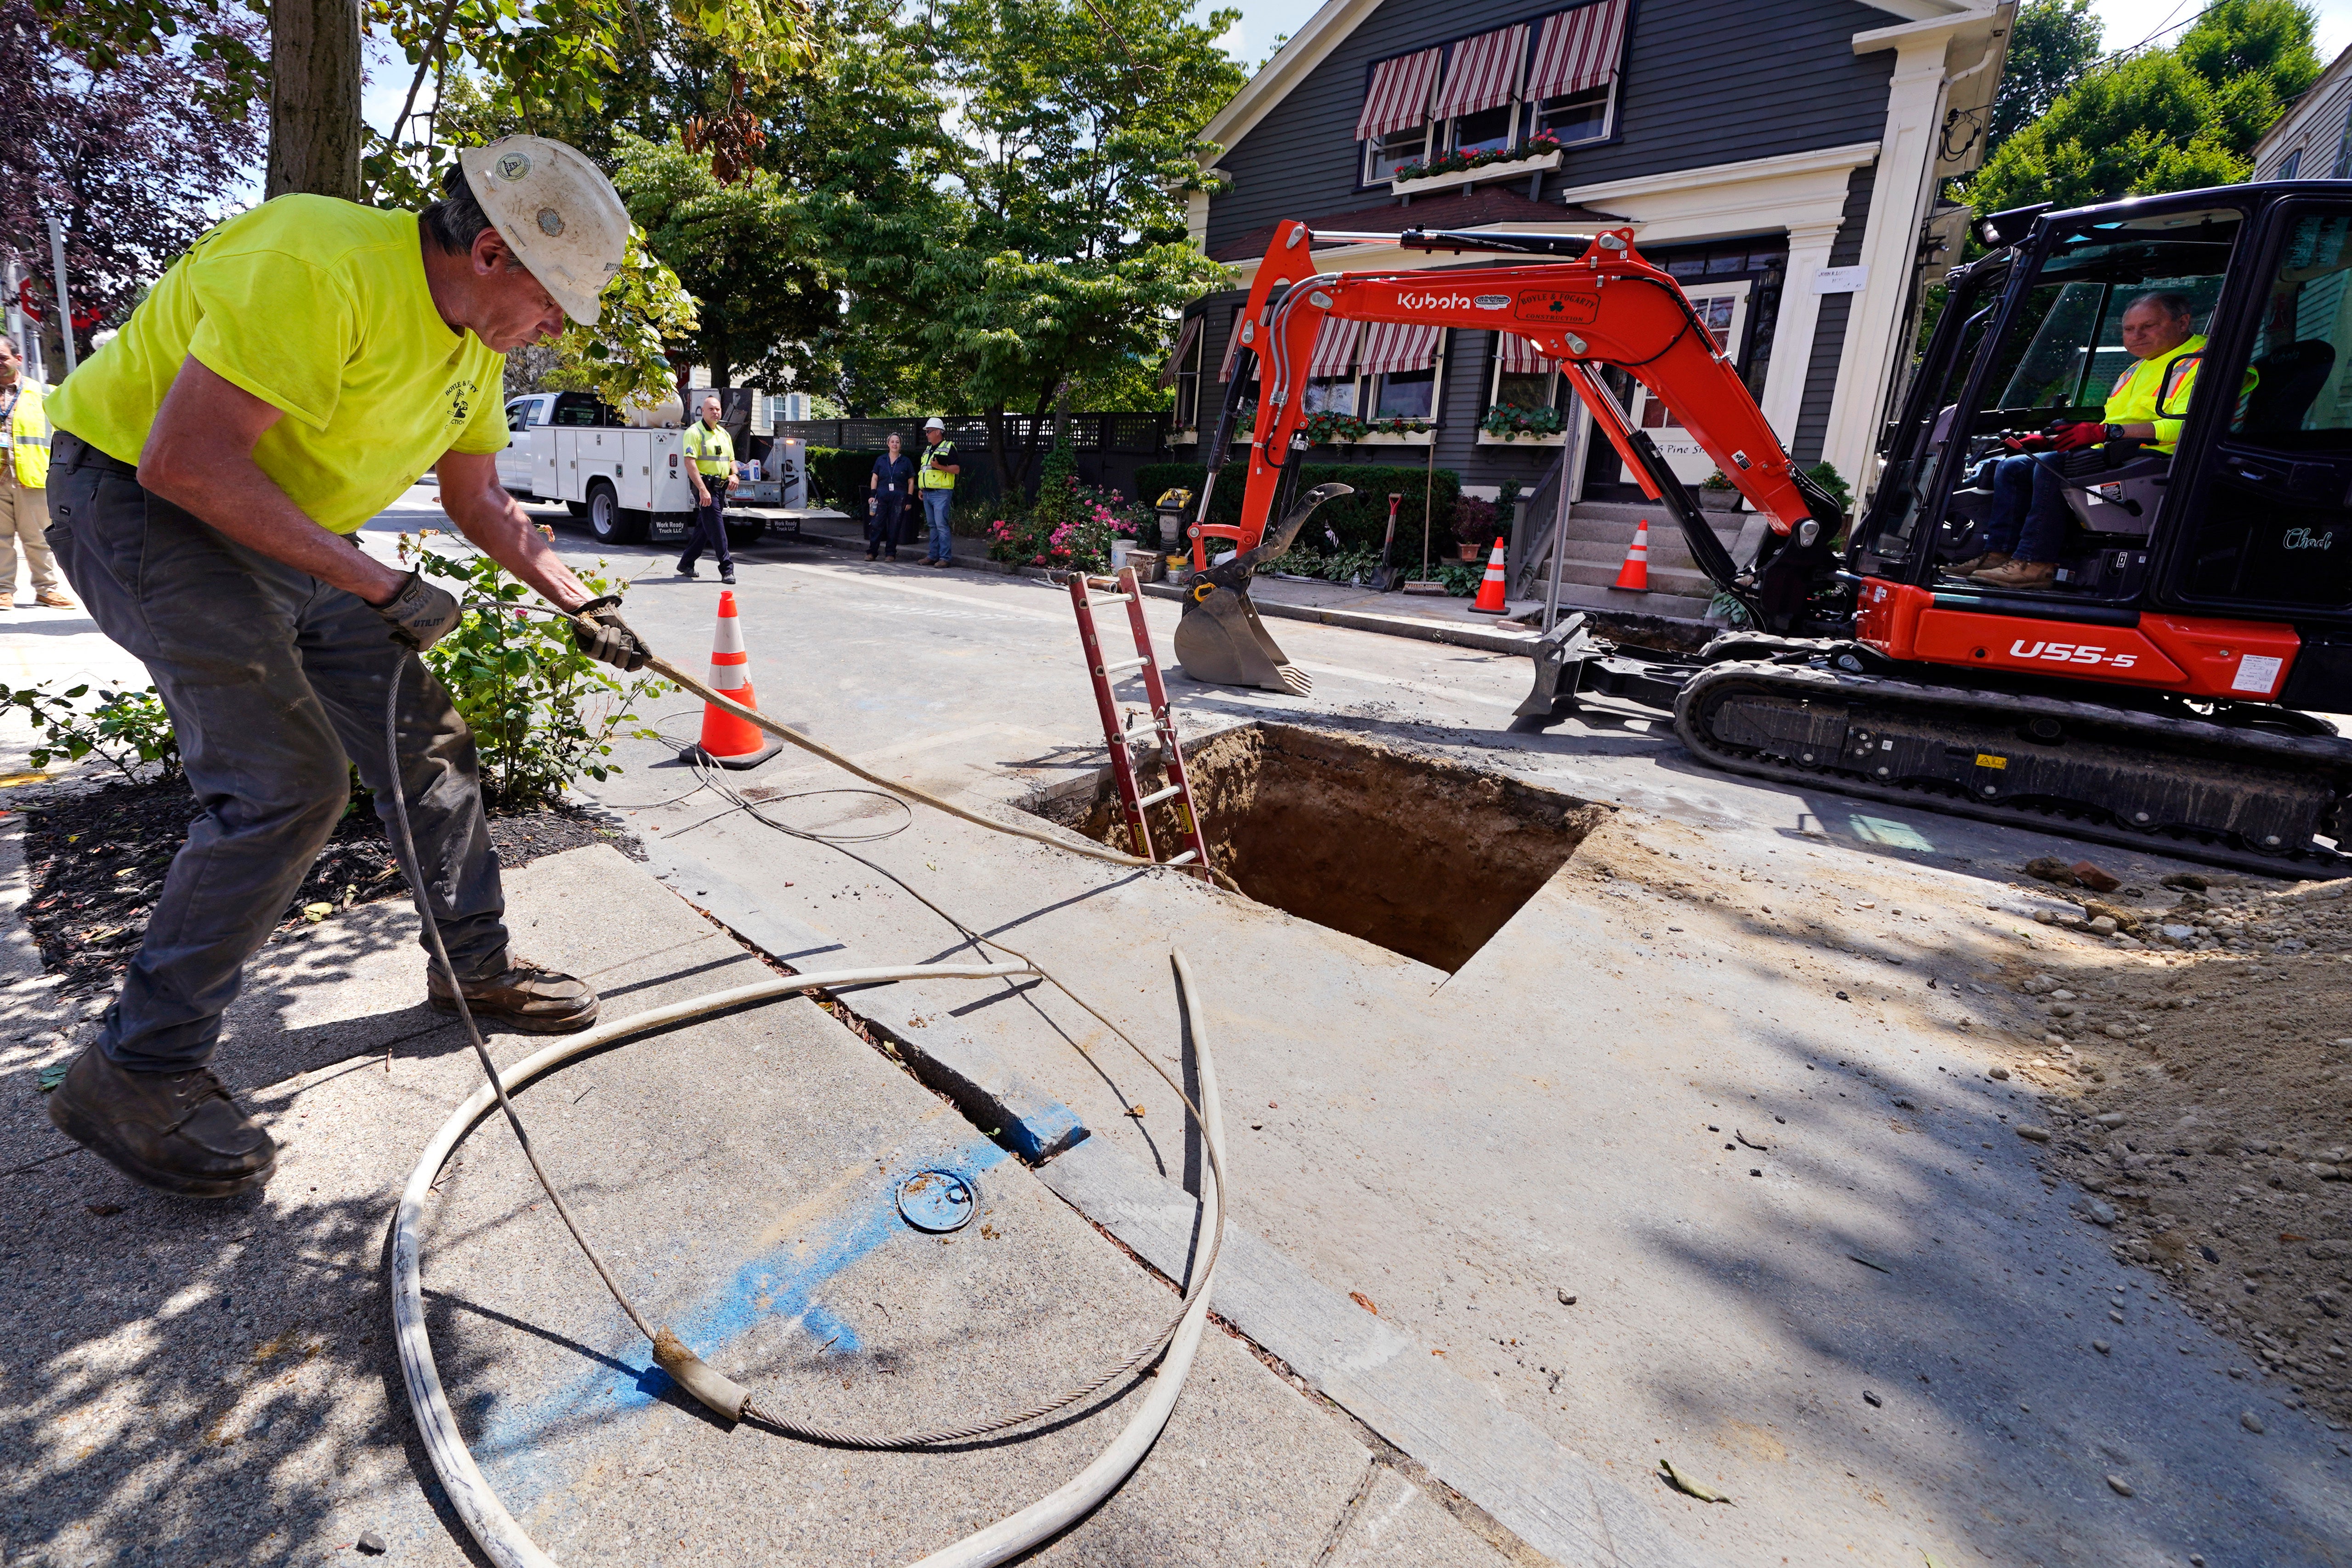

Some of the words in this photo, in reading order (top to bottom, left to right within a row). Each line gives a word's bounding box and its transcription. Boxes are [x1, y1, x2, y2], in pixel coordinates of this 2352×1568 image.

[1398, 293, 1470, 309] Kubota
[1521, 294, 1547, 305] BOYLE
[1559, 293, 1596, 309] FOGARTY
[1525, 313, 1583, 322] CONSTRUCTION
[445, 381, 461, 396] BOYLE
[1667, 445, 1689, 453] Pine
[2283, 528, 2332, 550] Chad
[414, 617, 445, 628] UTILITY
[2010, 639, 2138, 668] U55-5
[1179, 807, 1187, 831] CAUTION
[1135, 826, 1144, 851] CAUTION
